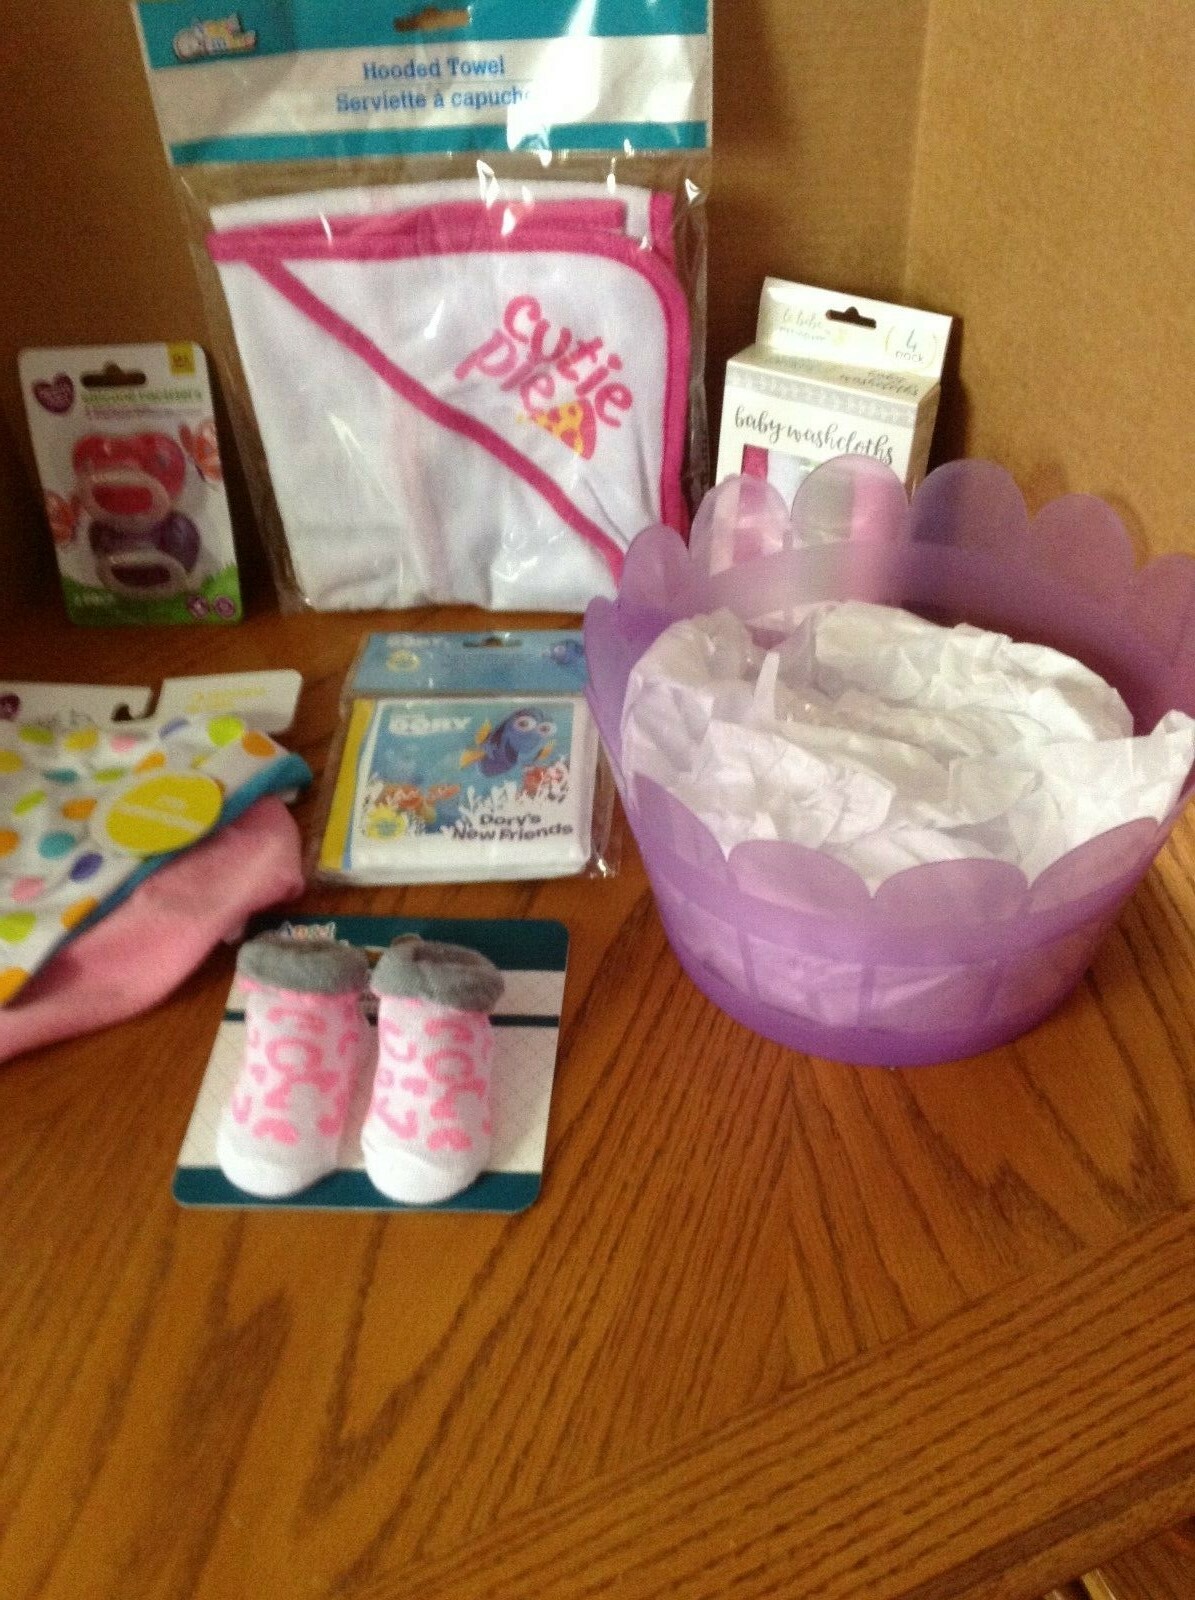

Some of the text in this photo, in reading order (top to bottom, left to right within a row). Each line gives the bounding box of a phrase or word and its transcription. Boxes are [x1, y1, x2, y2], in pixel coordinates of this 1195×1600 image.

[362, 55, 506, 81] Hooded Towel
[336, 84, 529, 113] Serviette à capuch
[734, 405, 894, 465] baby washcloths
[452, 822, 574, 842] New Friends
[478, 812, 542, 828] Dory's
